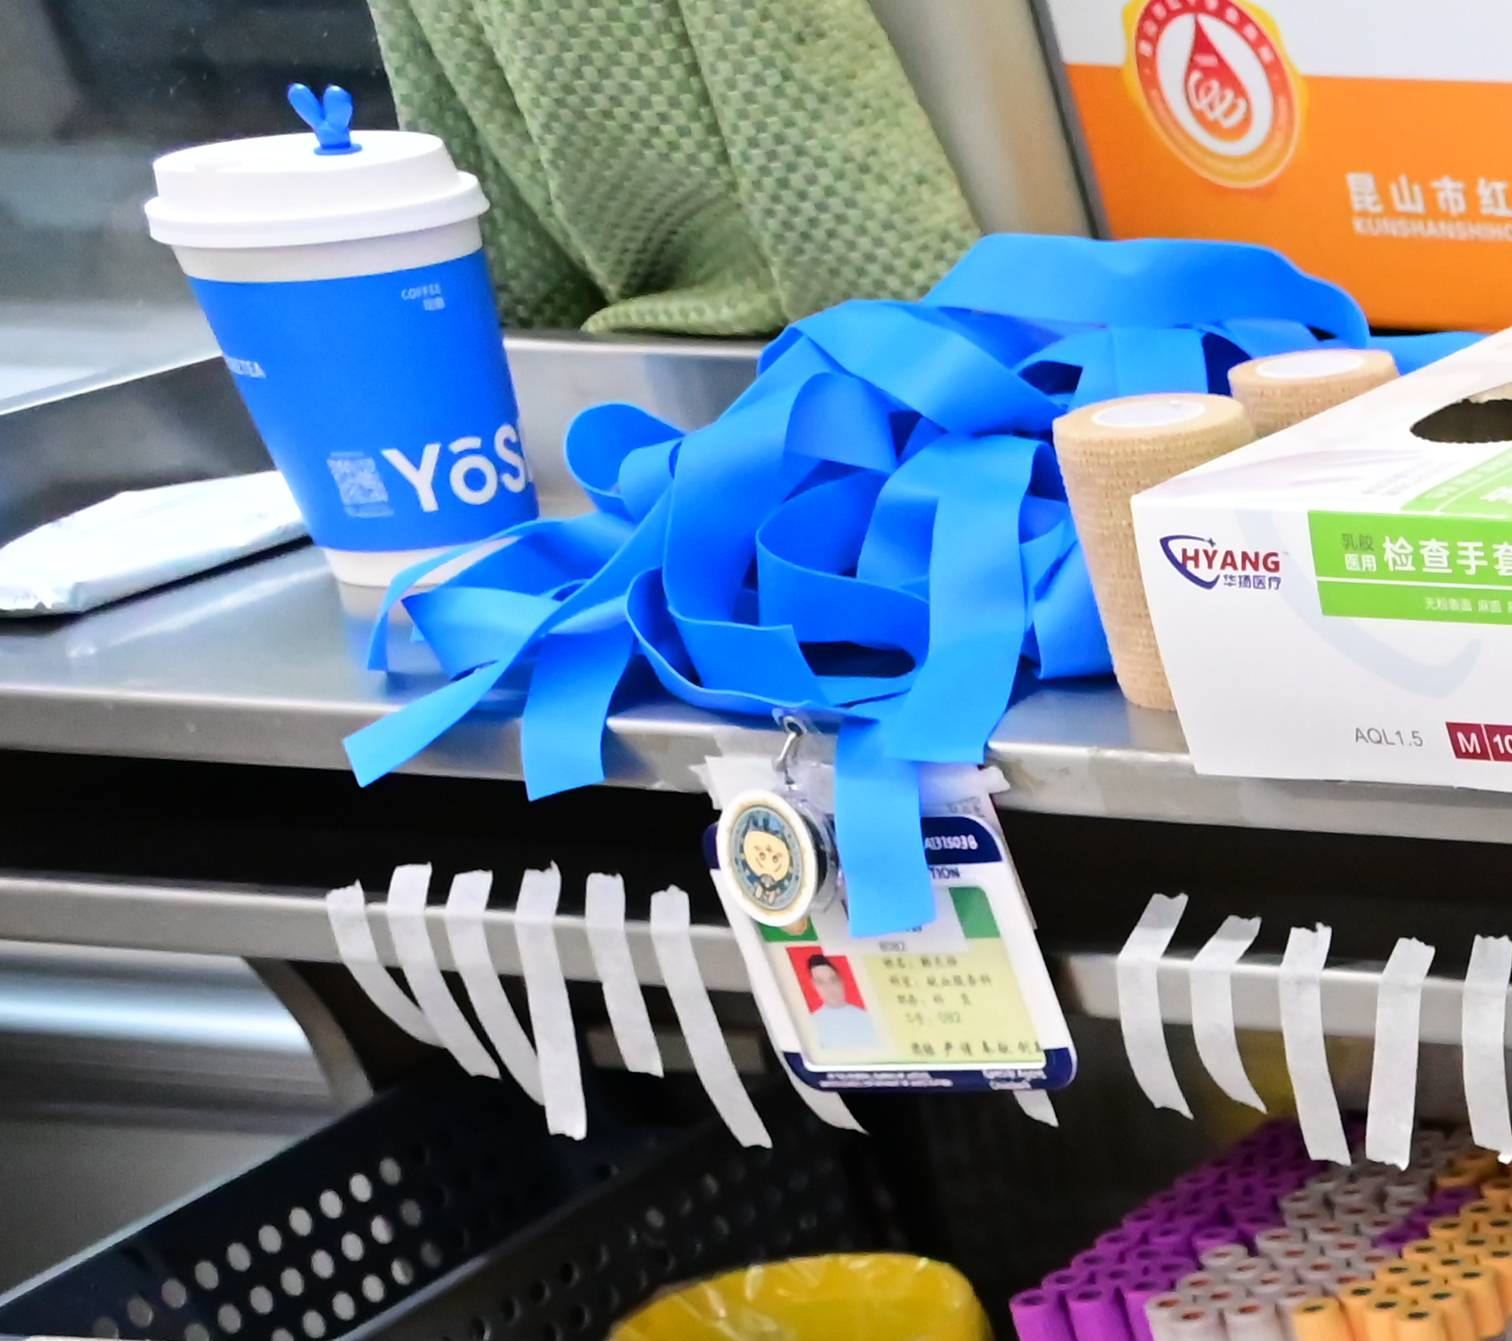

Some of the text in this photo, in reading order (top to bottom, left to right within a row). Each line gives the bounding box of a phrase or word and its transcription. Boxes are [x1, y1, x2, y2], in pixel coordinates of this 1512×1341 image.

[1182, 547, 1281, 573] HYANG
[1344, 553, 1377, 572] 医用
[1223, 574, 1282, 592] 华扬医疗
[1354, 727, 1424, 747] AQL1.5
[1456, 731, 1481, 754] M
